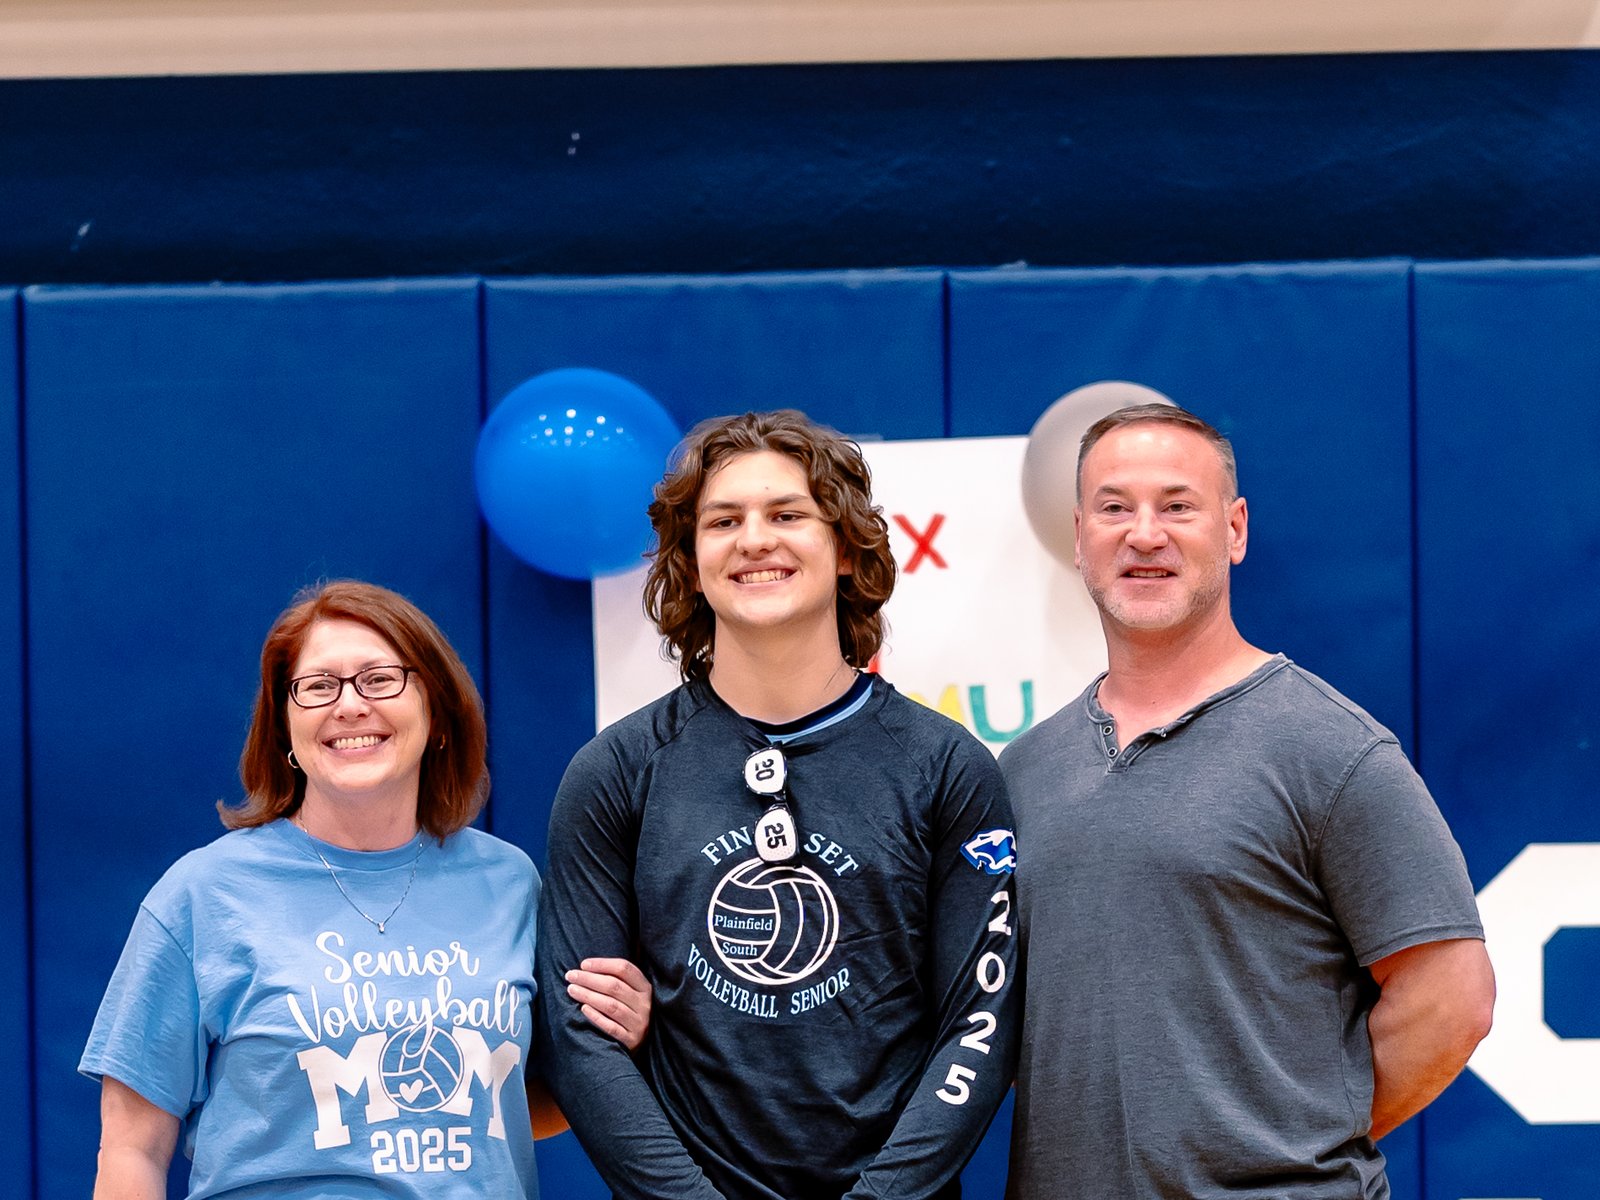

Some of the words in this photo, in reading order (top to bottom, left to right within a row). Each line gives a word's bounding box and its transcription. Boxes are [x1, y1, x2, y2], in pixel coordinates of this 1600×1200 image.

[764, 822, 787, 849] 25
[804, 833, 859, 877] SET
[714, 915, 773, 931] Plainfield
[315, 931, 479, 983] Senior
[722, 942, 758, 957] South
[688, 943, 779, 1018] VOLLEYBALL
[790, 967, 850, 1016] SENIOR
[935, 891, 1011, 1105] 2025
[287, 976, 522, 1058] Volleyball
[370, 1127, 473, 1174] 2025
